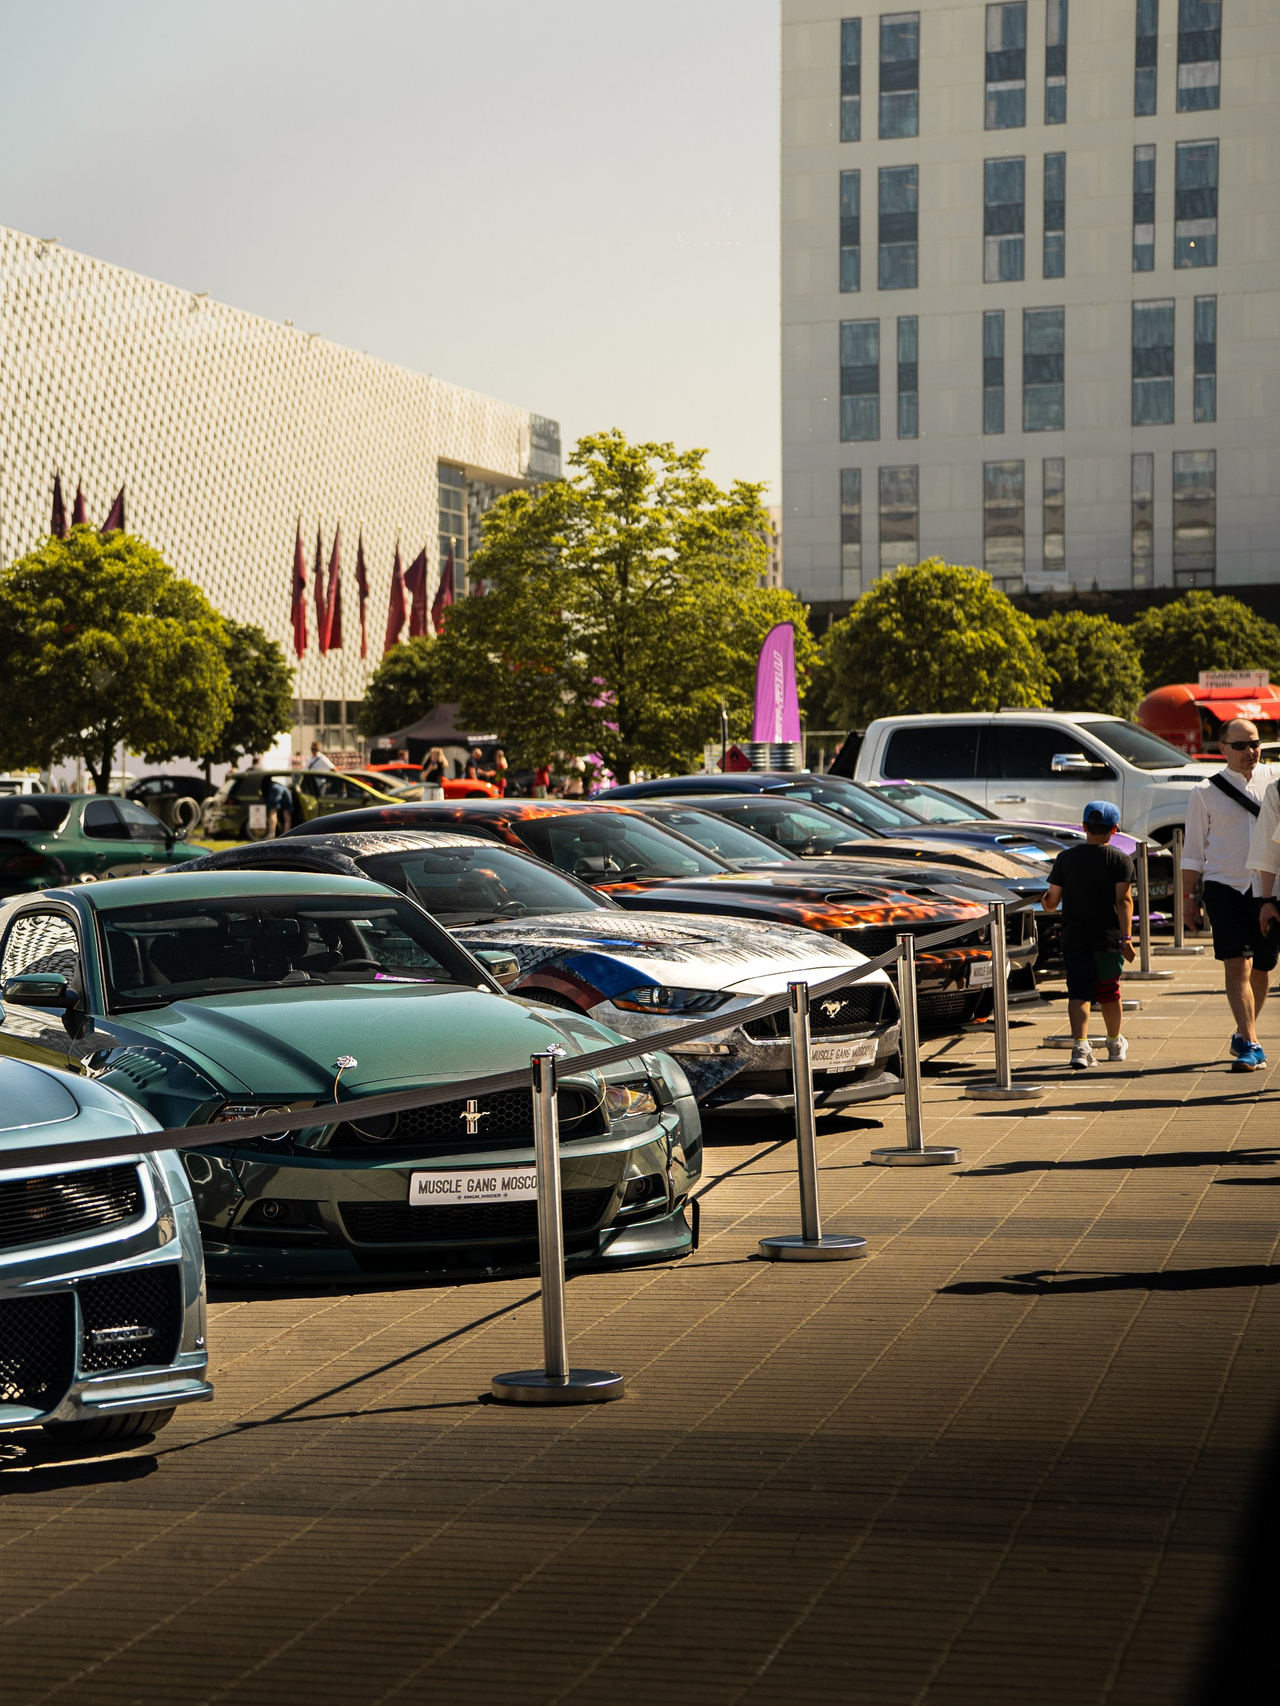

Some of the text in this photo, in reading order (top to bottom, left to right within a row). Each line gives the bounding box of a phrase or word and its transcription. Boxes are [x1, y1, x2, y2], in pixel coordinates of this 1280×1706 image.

[811, 1049, 835, 1061] MUSCLE
[836, 1047, 851, 1060] GANG
[418, 1174, 538, 1194] MUSCLE GANG MOSCO
